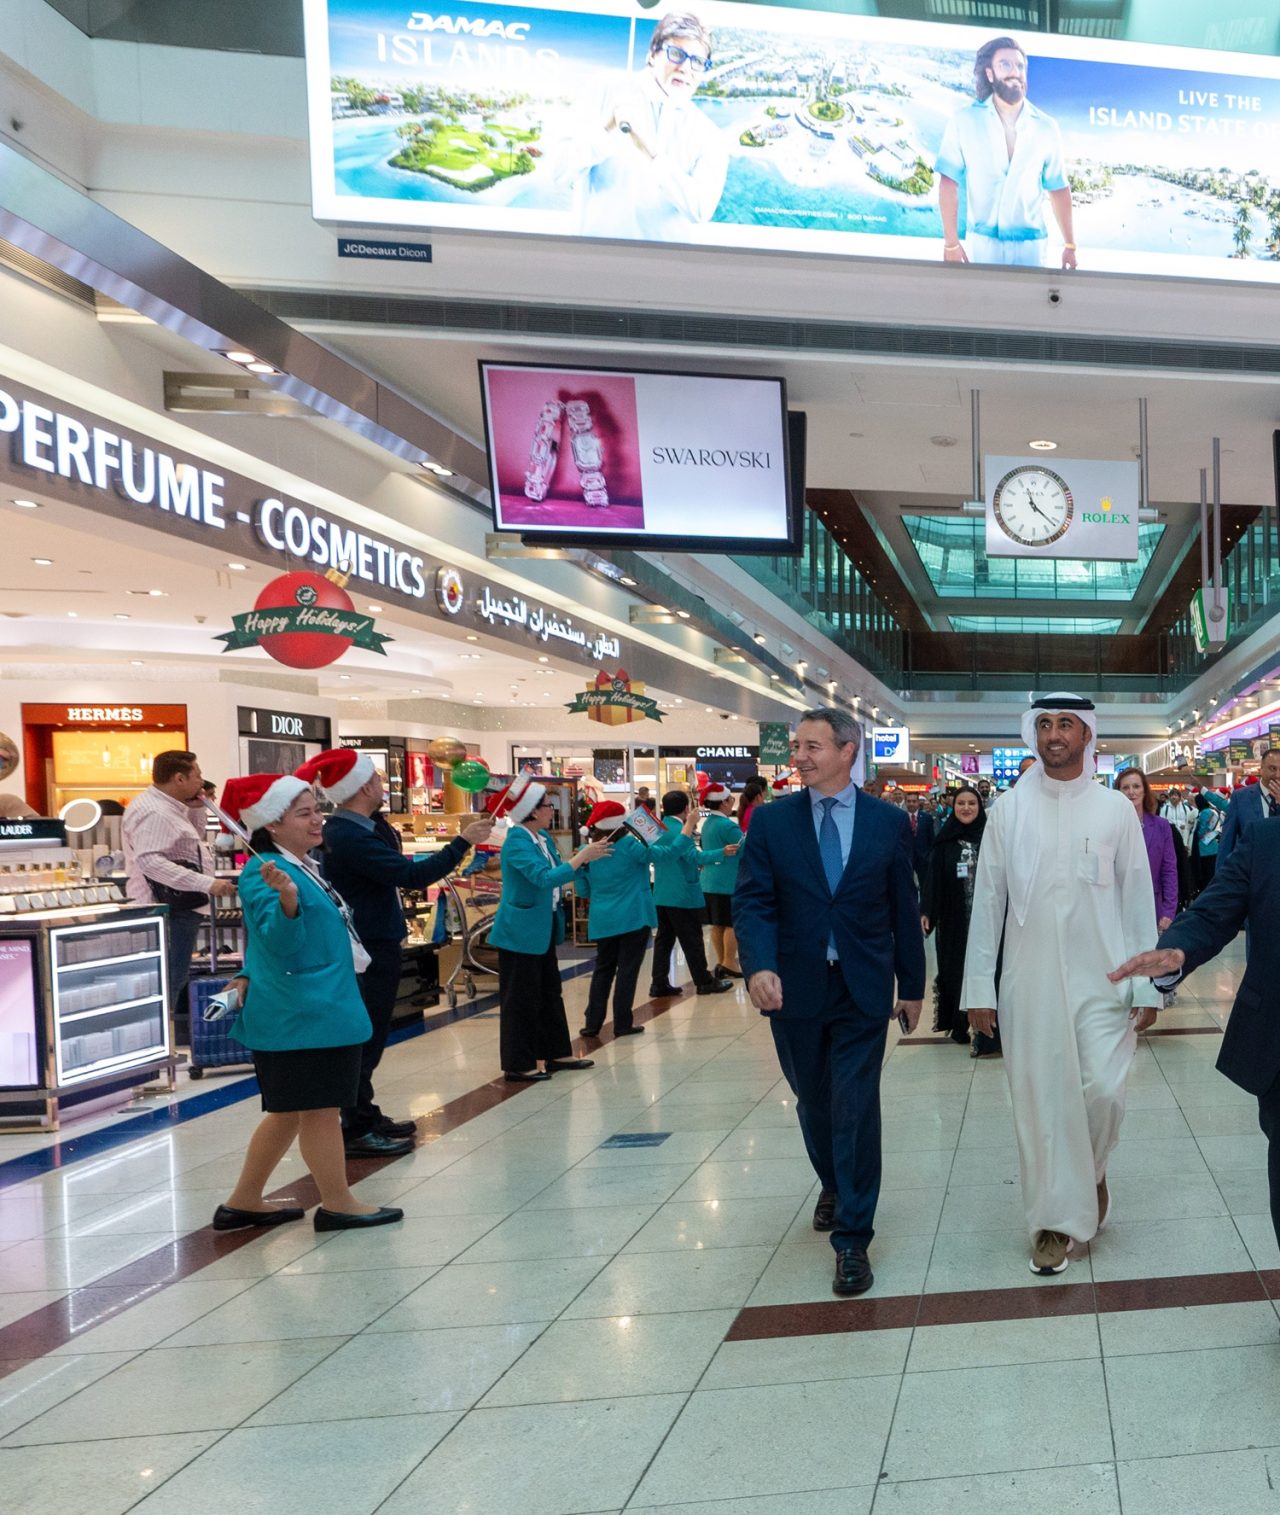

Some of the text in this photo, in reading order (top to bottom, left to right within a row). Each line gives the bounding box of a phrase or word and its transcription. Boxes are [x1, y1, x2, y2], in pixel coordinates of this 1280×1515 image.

[407, 12, 531, 40] DAMAC
[377, 33, 560, 79] ISLANDS
[1178, 89, 1262, 112] LIVE THE
[1089, 106, 1172, 131] ISLAND
[1178, 114, 1246, 138] STATE
[343, 243, 428, 258] JCDecaux Dicon
[652, 446, 772, 470] SWAROVSKI
[0, 388, 227, 530] PERFUME
[259, 497, 427, 599] COSMETICS
[1081, 511, 1131, 525] ROLEX
[480, 586, 528, 626] التجميل
[244, 607, 371, 636] Happy Holidays!
[529, 608, 586, 642] مستحضرات
[592, 632, 622, 661] العطور
[581, 692, 608, 706] Happy
[67, 706, 144, 721] HERMÈS
[271, 714, 304, 736] DIOR
[875, 734, 897, 743] hotel
[696, 746, 752, 758] CHANEL
